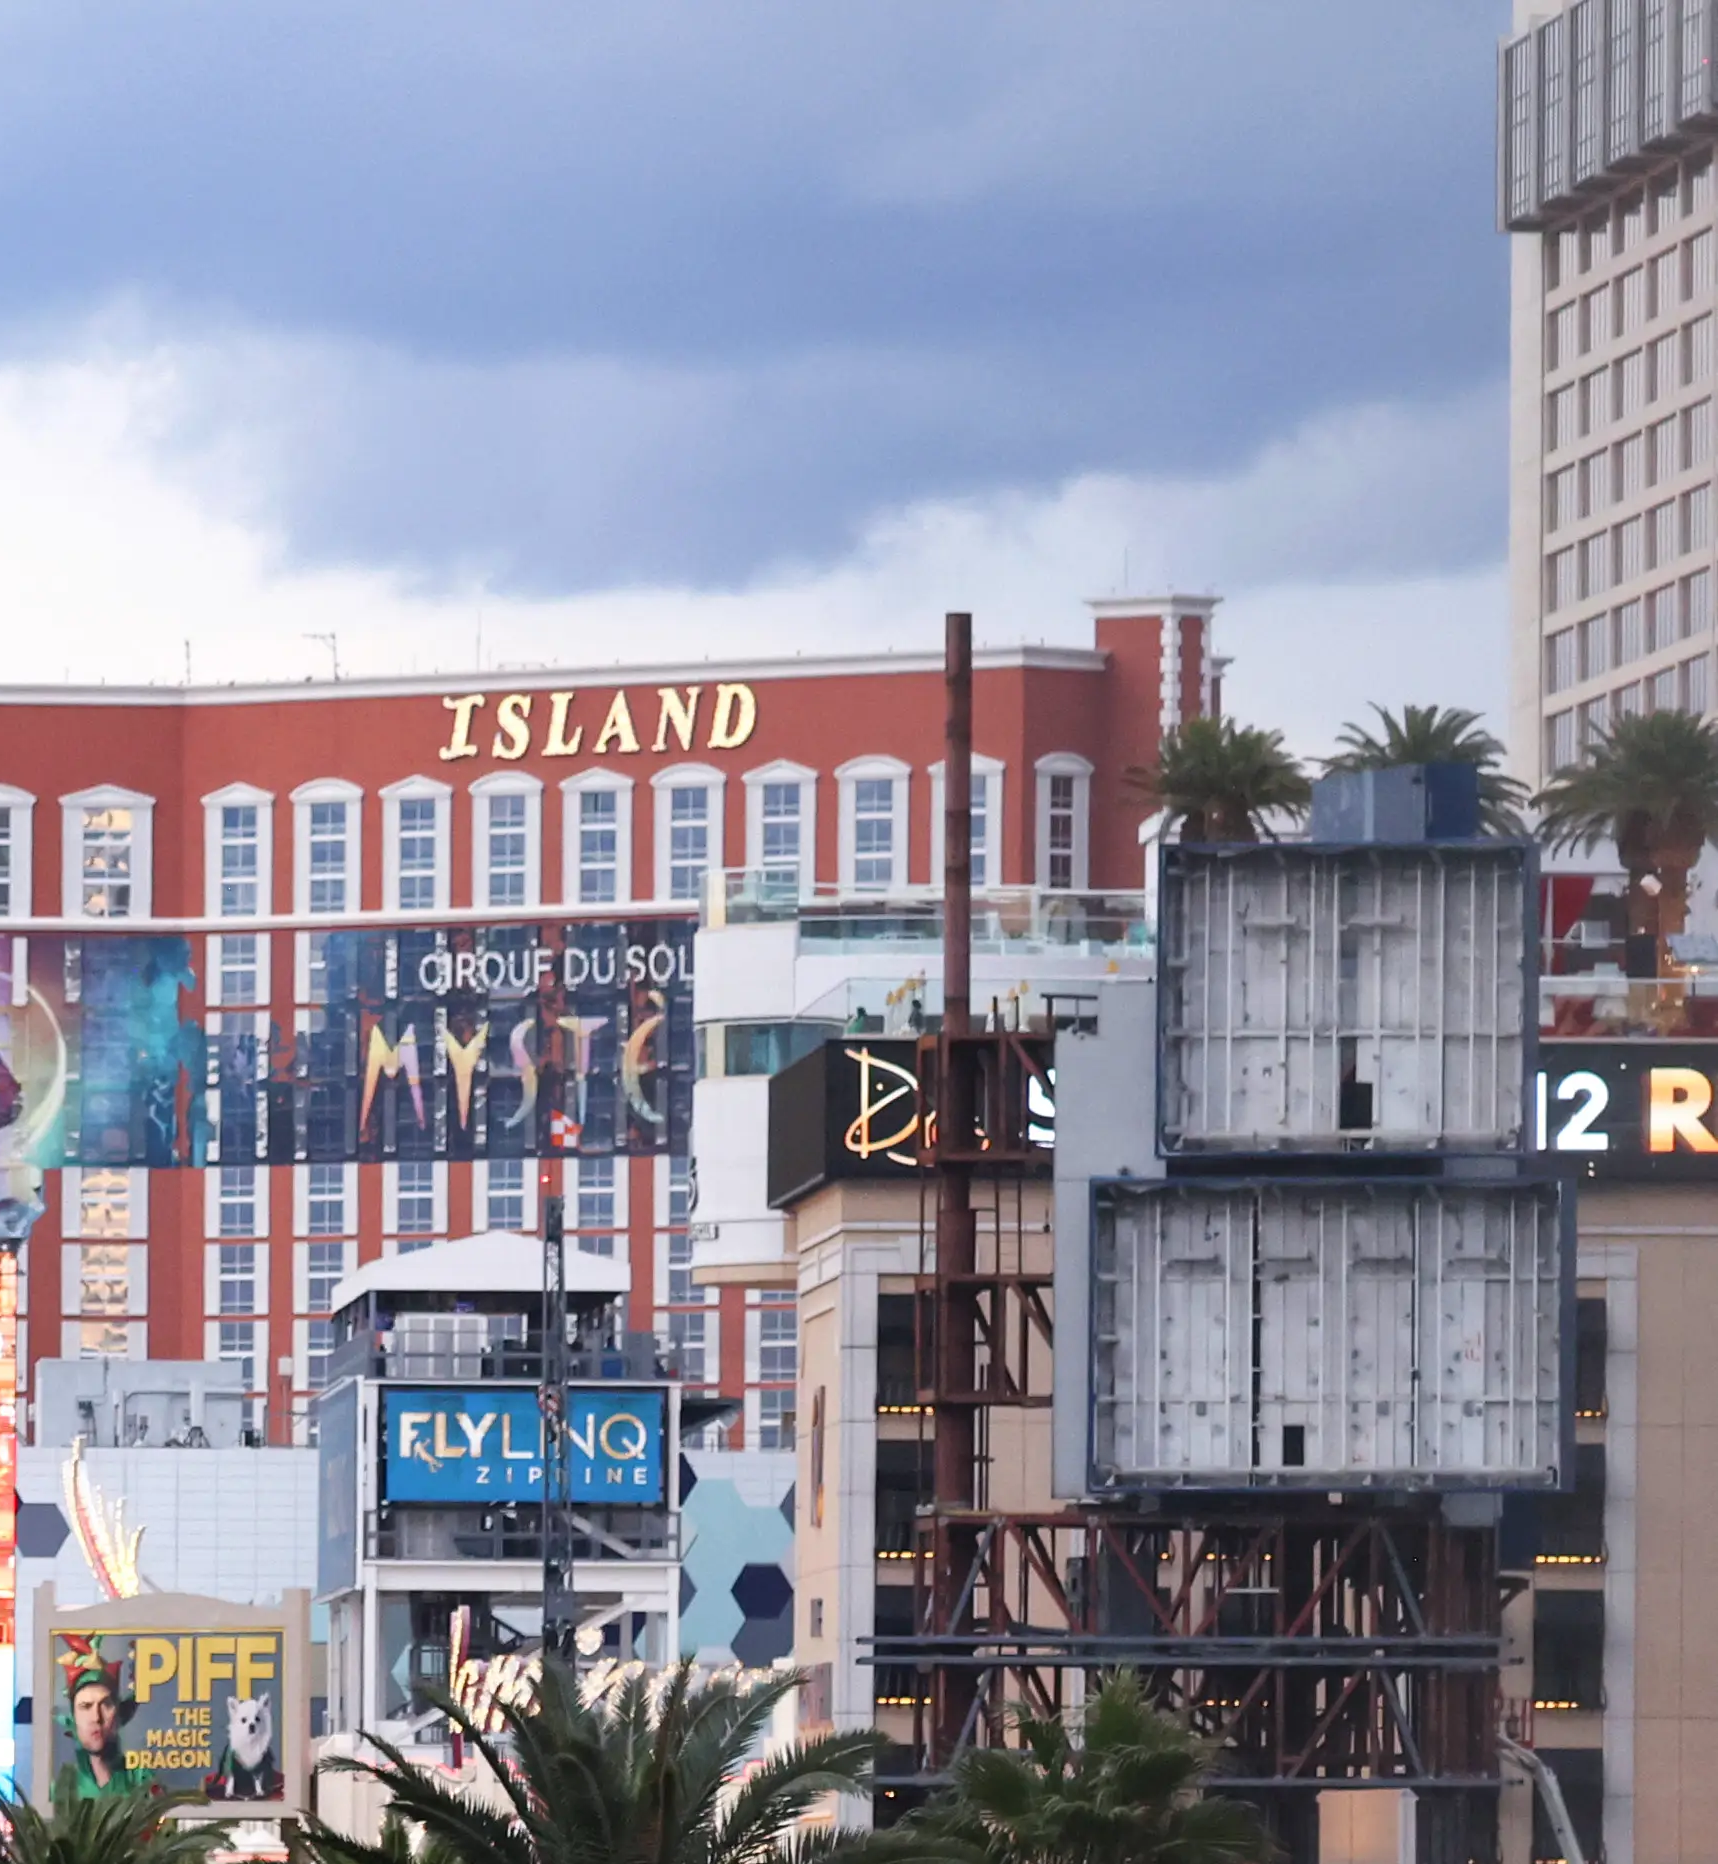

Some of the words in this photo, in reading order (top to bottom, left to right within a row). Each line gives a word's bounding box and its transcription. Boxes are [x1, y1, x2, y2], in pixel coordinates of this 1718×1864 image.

[439, 682, 759, 761] ISLAND
[564, 947, 615, 985] DU
[134, 1636, 277, 1704] PIFF
[171, 1707, 212, 1727] THE
[146, 1728, 212, 1748] MAGIC
[125, 1749, 212, 1770] DRAGON
